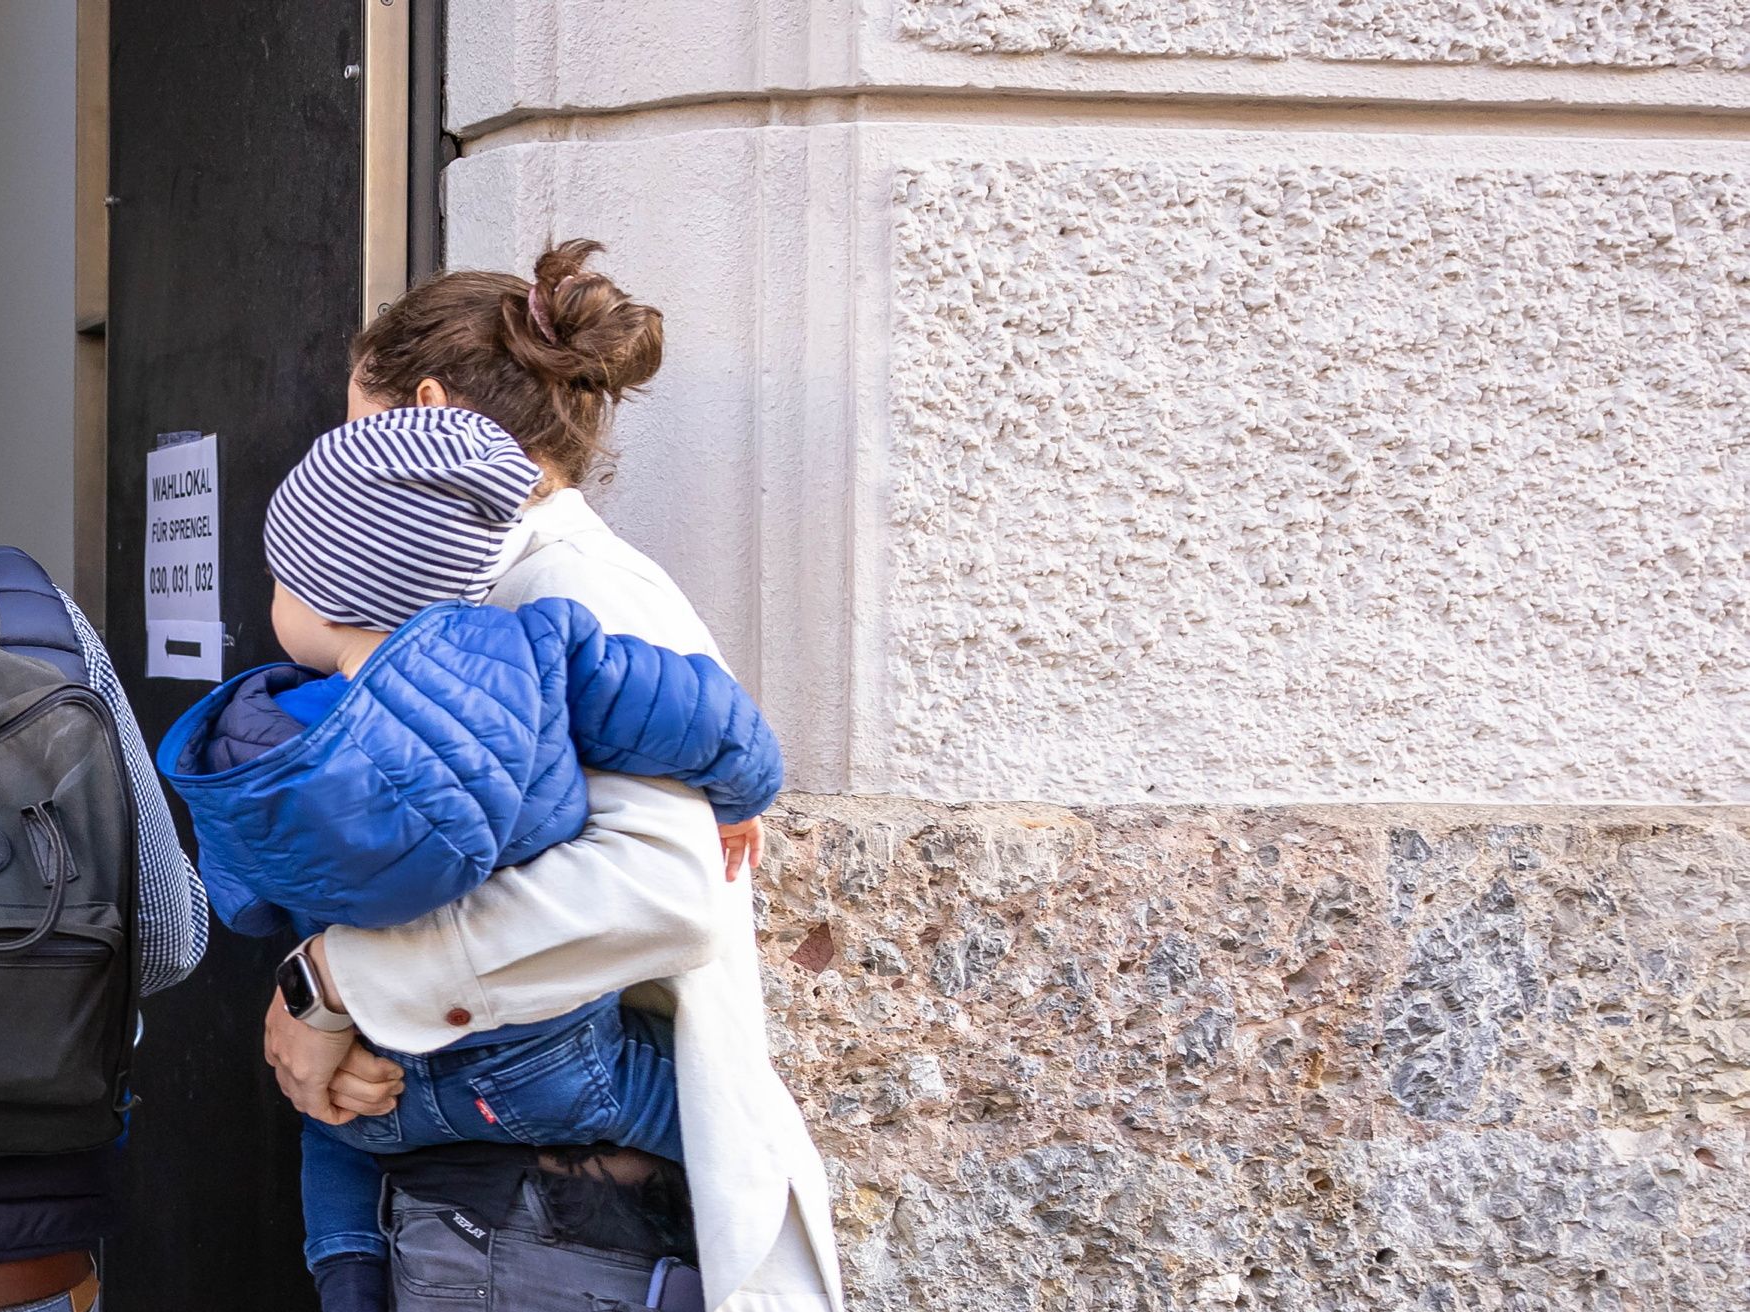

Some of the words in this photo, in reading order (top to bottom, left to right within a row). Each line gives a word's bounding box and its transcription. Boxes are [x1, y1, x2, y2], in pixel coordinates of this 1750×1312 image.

[152, 467, 212, 502] WAHLLOKAL
[152, 517, 168, 544] FÜR
[169, 515, 212, 542] SPRENGEL
[150, 566, 170, 599] 030,
[172, 564, 193, 598] 031,
[195, 562, 213, 592] 032
